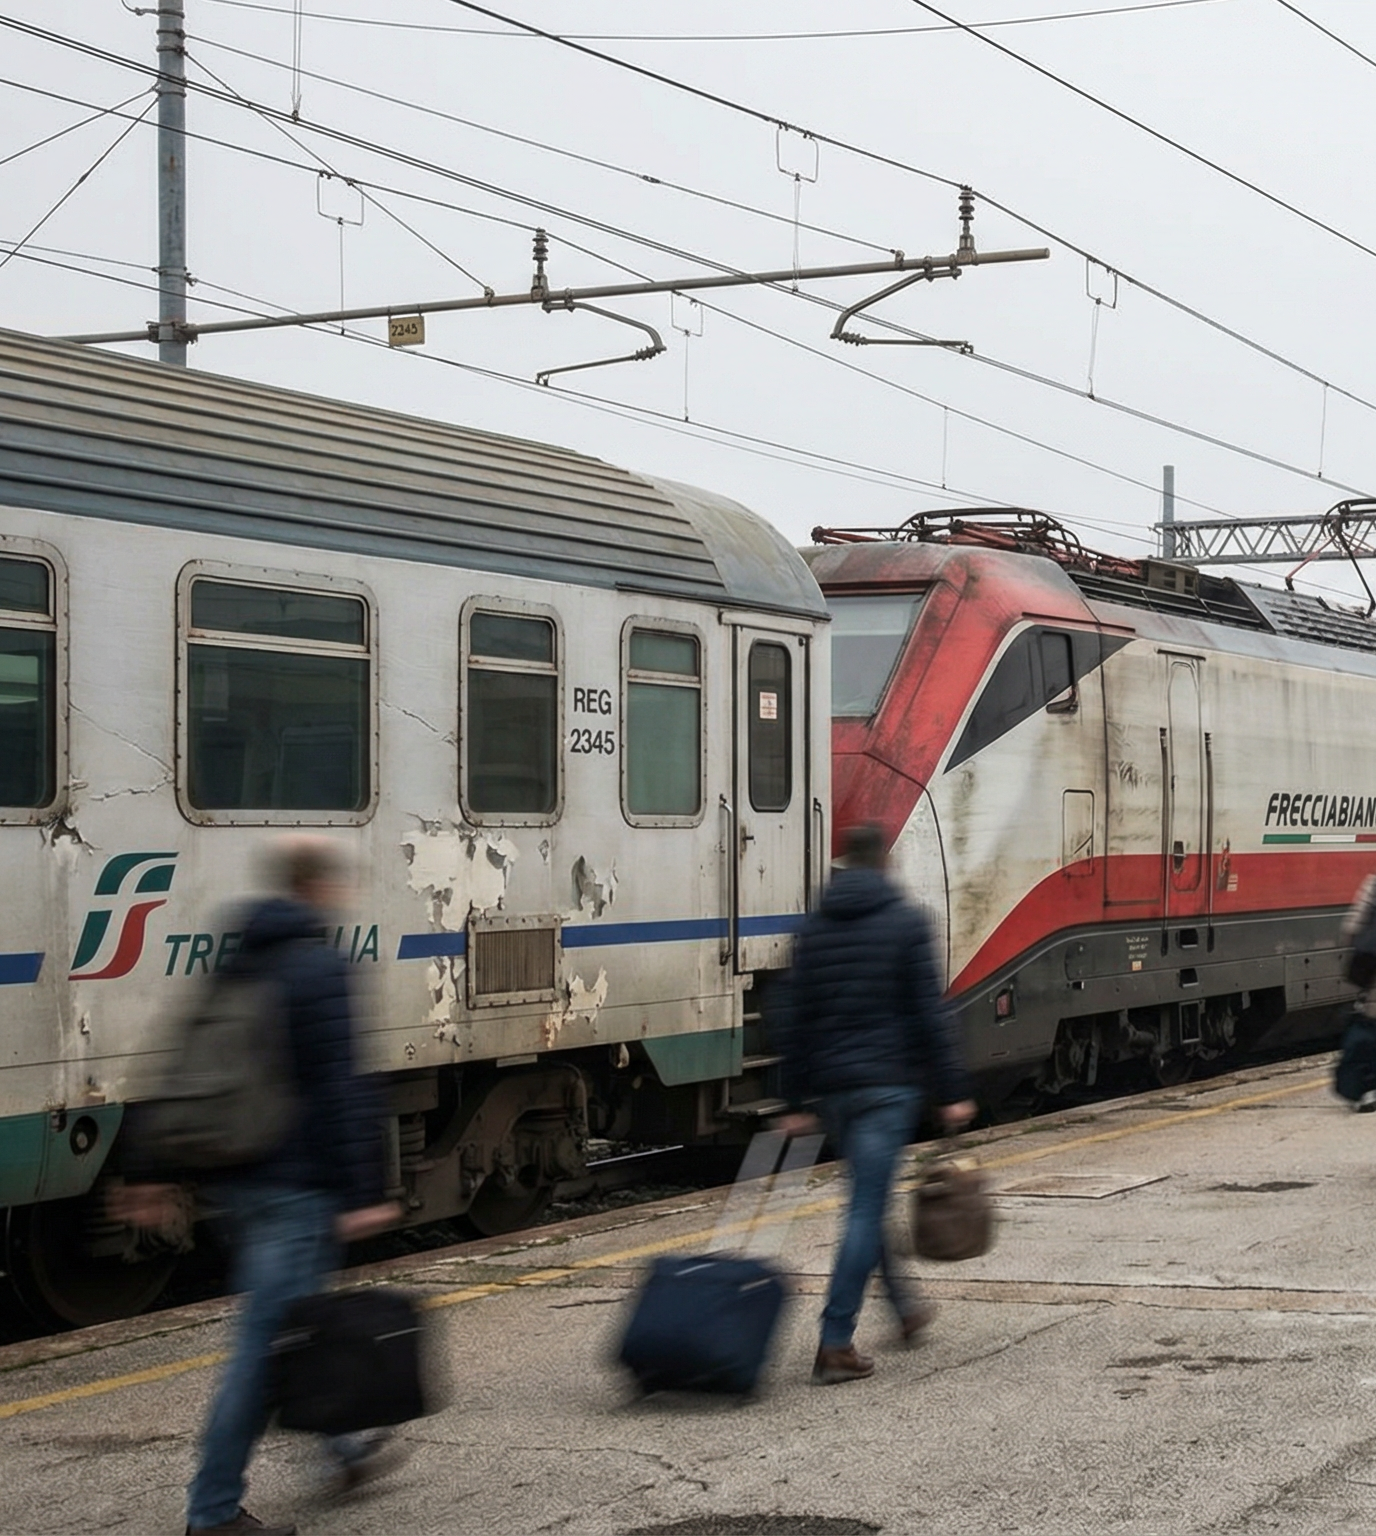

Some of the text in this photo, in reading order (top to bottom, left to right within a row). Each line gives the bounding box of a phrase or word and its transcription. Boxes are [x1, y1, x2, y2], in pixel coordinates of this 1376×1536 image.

[574, 687, 612, 715] REG
[570, 728, 615, 755] 2345
[164, 924, 379, 977] TRELIA
